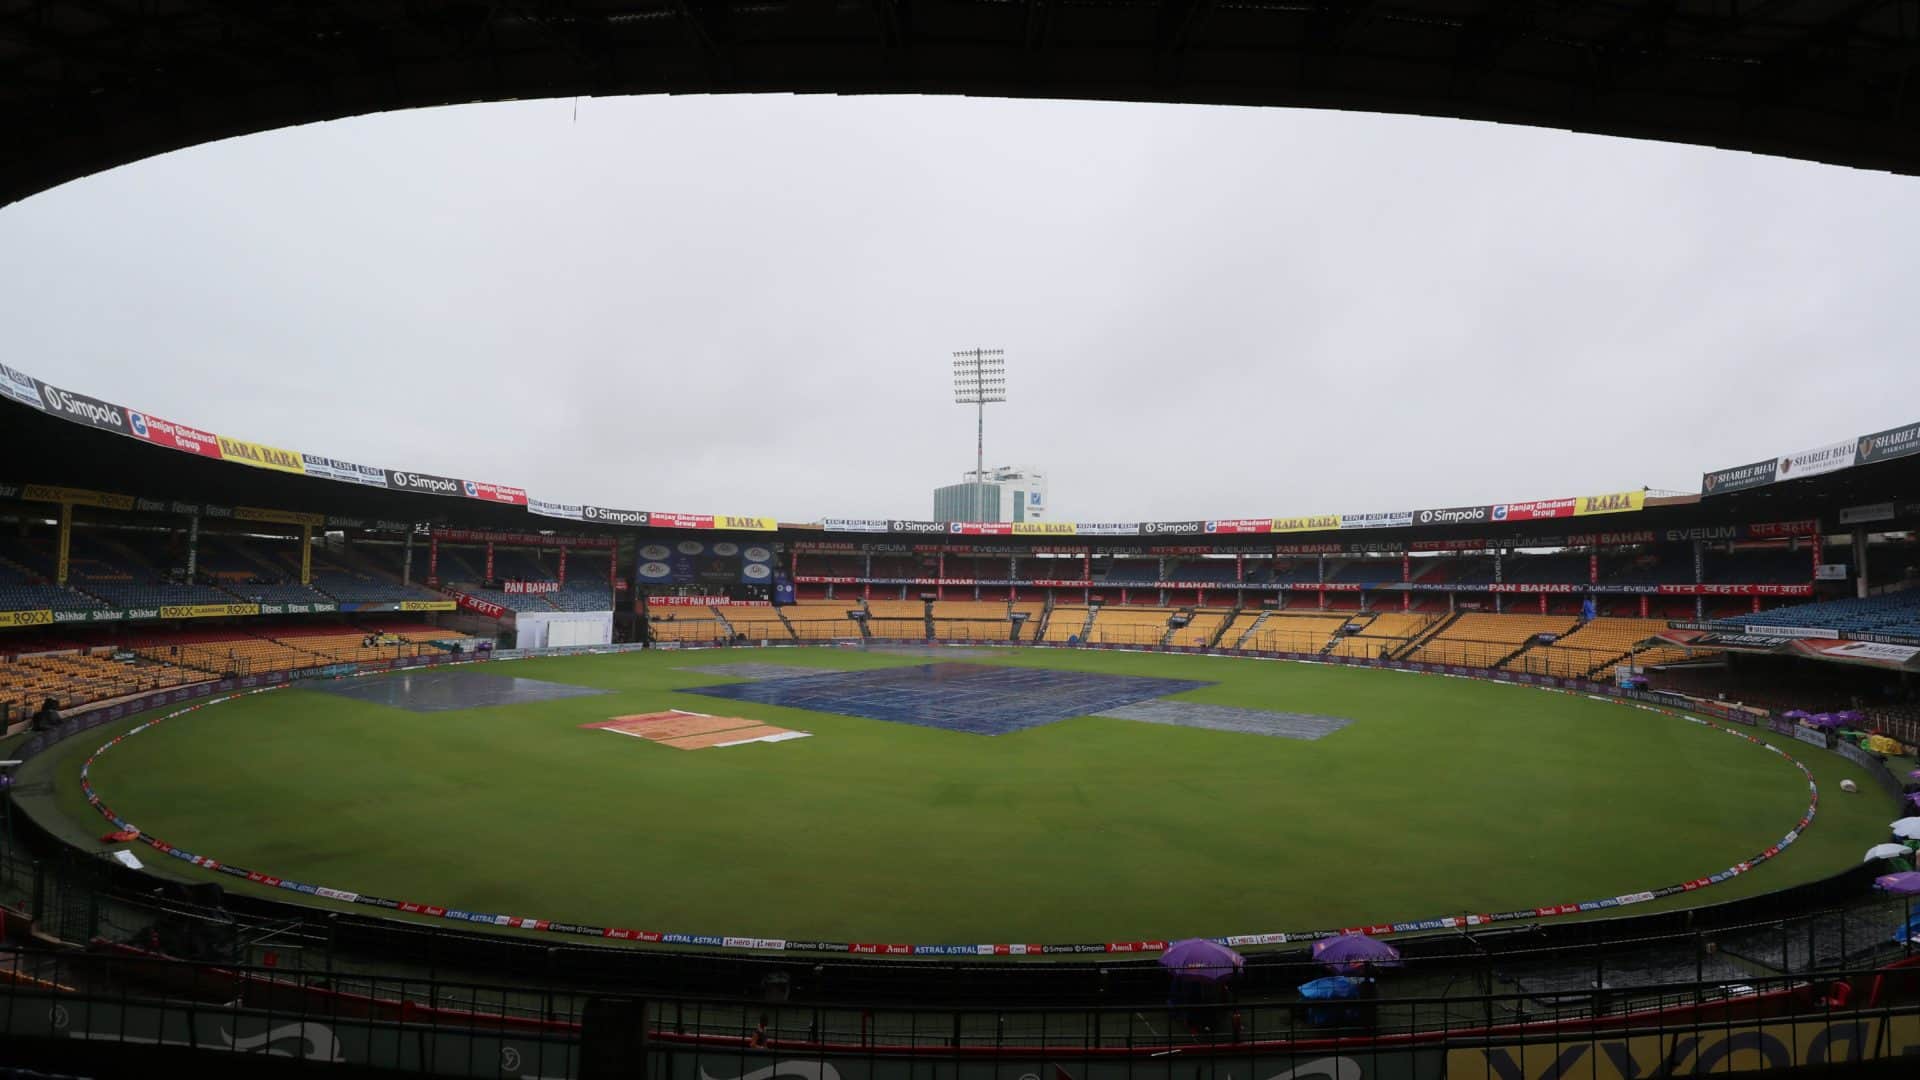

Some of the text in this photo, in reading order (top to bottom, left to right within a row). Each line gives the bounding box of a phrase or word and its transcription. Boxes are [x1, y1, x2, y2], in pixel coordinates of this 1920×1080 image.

[60, 391, 121, 428] Simpolo
[146, 416, 216, 445] Sanjay Ghodawat
[176, 435, 201, 452] Group
[1875, 428, 1913, 448] SHARIEF
[1793, 444, 1856, 465] SHARIEF BHAI
[1718, 463, 1776, 482] SHARIEF BHAI
[409, 475, 456, 492] Simpolo
[1509, 499, 1575, 513] Sanjay Ghodawat
[600, 509, 647, 524] Simpolo
[650, 512, 712, 523] Sanjay Ghodawat
[1435, 509, 1485, 523] Simpolo
[1532, 509, 1555, 518] Group
[674, 520, 696, 528] Group
[905, 521, 945, 533] Simpolo
[1158, 522, 1198, 534] Simpolo
[1750, 520, 1814, 534] पान बहार
[1568, 530, 1655, 545] PAN BAHAR
[1667, 527, 1736, 541] EVEIUM
[795, 542, 854, 550] PAN BAHAR
[1276, 544, 1342, 553] PAN BAHAR
[939, 577, 974, 585] BAHAR
[1154, 581, 1215, 589] PAN BAHAR
[505, 582, 559, 593] PAN BAHAR
[1489, 584, 1571, 592] PAN BAHAR
[1662, 585, 1752, 594] पान बहार
[690, 597, 704, 605] PAN
[706, 596, 730, 605] BAHAR
[93, 610, 123, 621] Shikhar
[129, 608, 158, 619] Shikhar
[162, 606, 193, 617] ROXX
[227, 605, 256, 615] ROXX
[14, 610, 49, 624] ROXX
[55, 611, 87, 622] Shikhar
[446, 910, 495, 923] ASTRAL ASTRAL
[1394, 920, 1443, 932] ASTRAL ASTRAL
[608, 929, 629, 938] Amul
[637, 932, 658, 941] Amul
[662, 934, 722, 946] ASTRAL ASTRAL
[854, 944, 877, 953] Amul
[885, 944, 909, 953] Amul
[915, 945, 977, 954] ASTRAL ASTRAL
[1112, 943, 1133, 952] Amul
[1141, 941, 1164, 951] Amul
